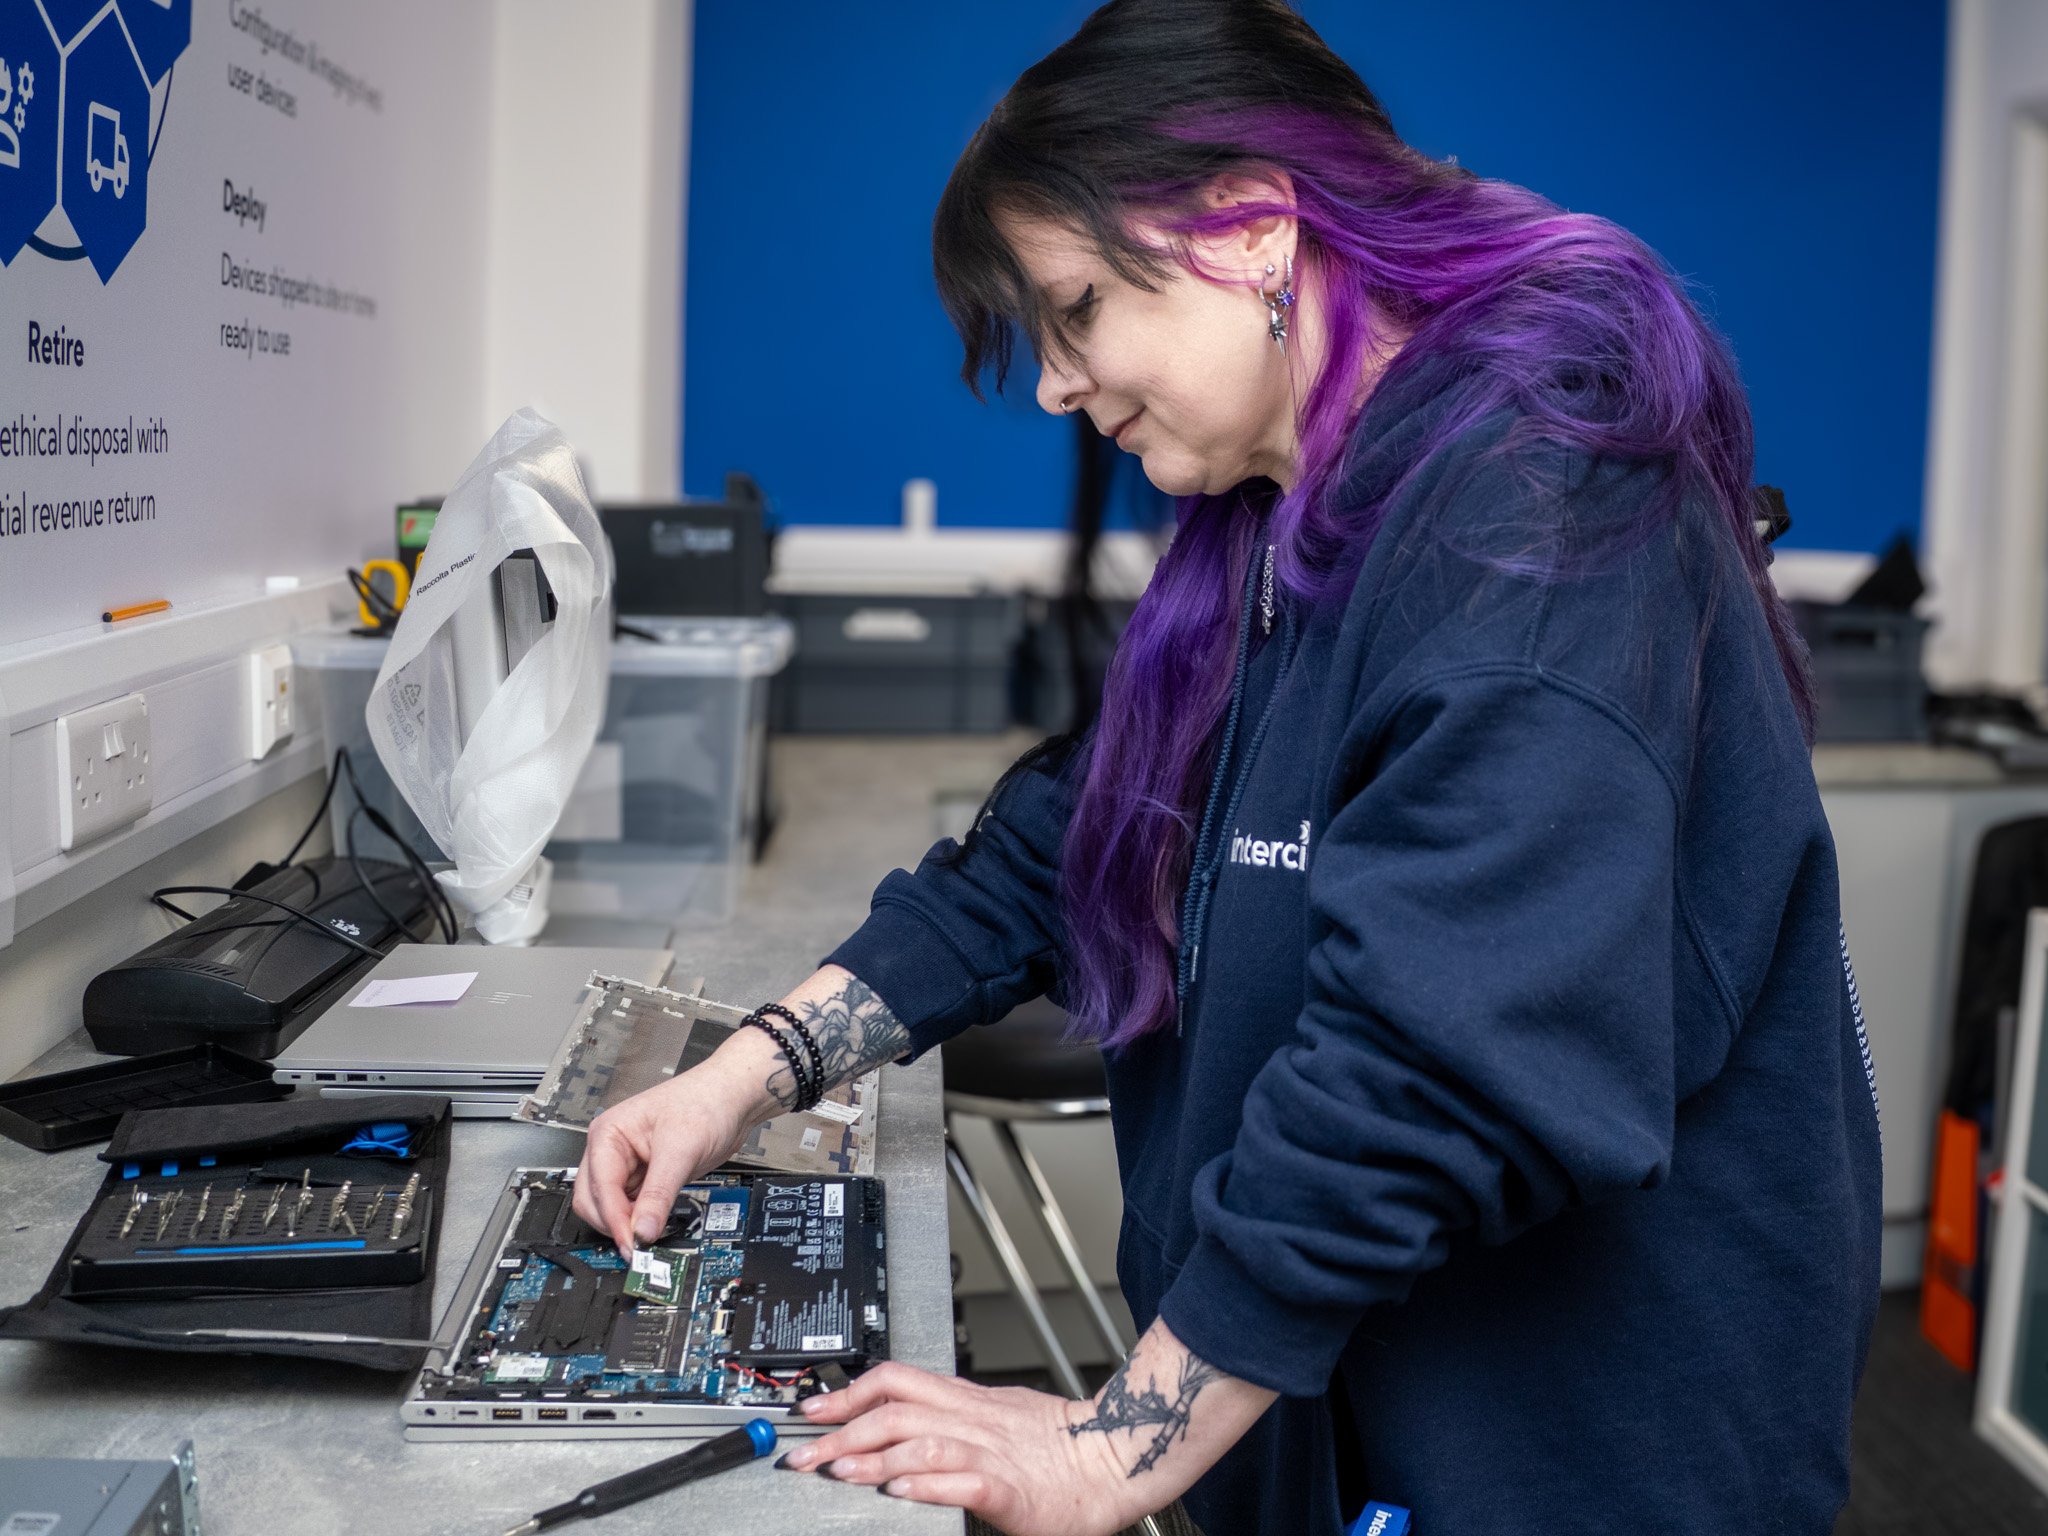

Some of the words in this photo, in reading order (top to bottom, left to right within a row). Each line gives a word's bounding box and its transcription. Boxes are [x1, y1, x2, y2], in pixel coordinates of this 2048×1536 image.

[228, 62, 253, 95] user
[255, 70, 297, 119] devices
[223, 178, 267, 234] Deploy
[221, 252, 267, 294] Devices
[268, 264, 311, 310] shipped
[29, 320, 84, 367] Retire
[220, 317, 254, 359] ready
[257, 325, 269, 353] to
[272, 332, 290, 356] use
[0, 414, 62, 457] ethical
[67, 415, 133, 467] disposal
[137, 417, 168, 453] with
[32, 498, 104, 533] revenue
[108, 491, 156, 524] return
[416, 570, 449, 596] Raccolta
